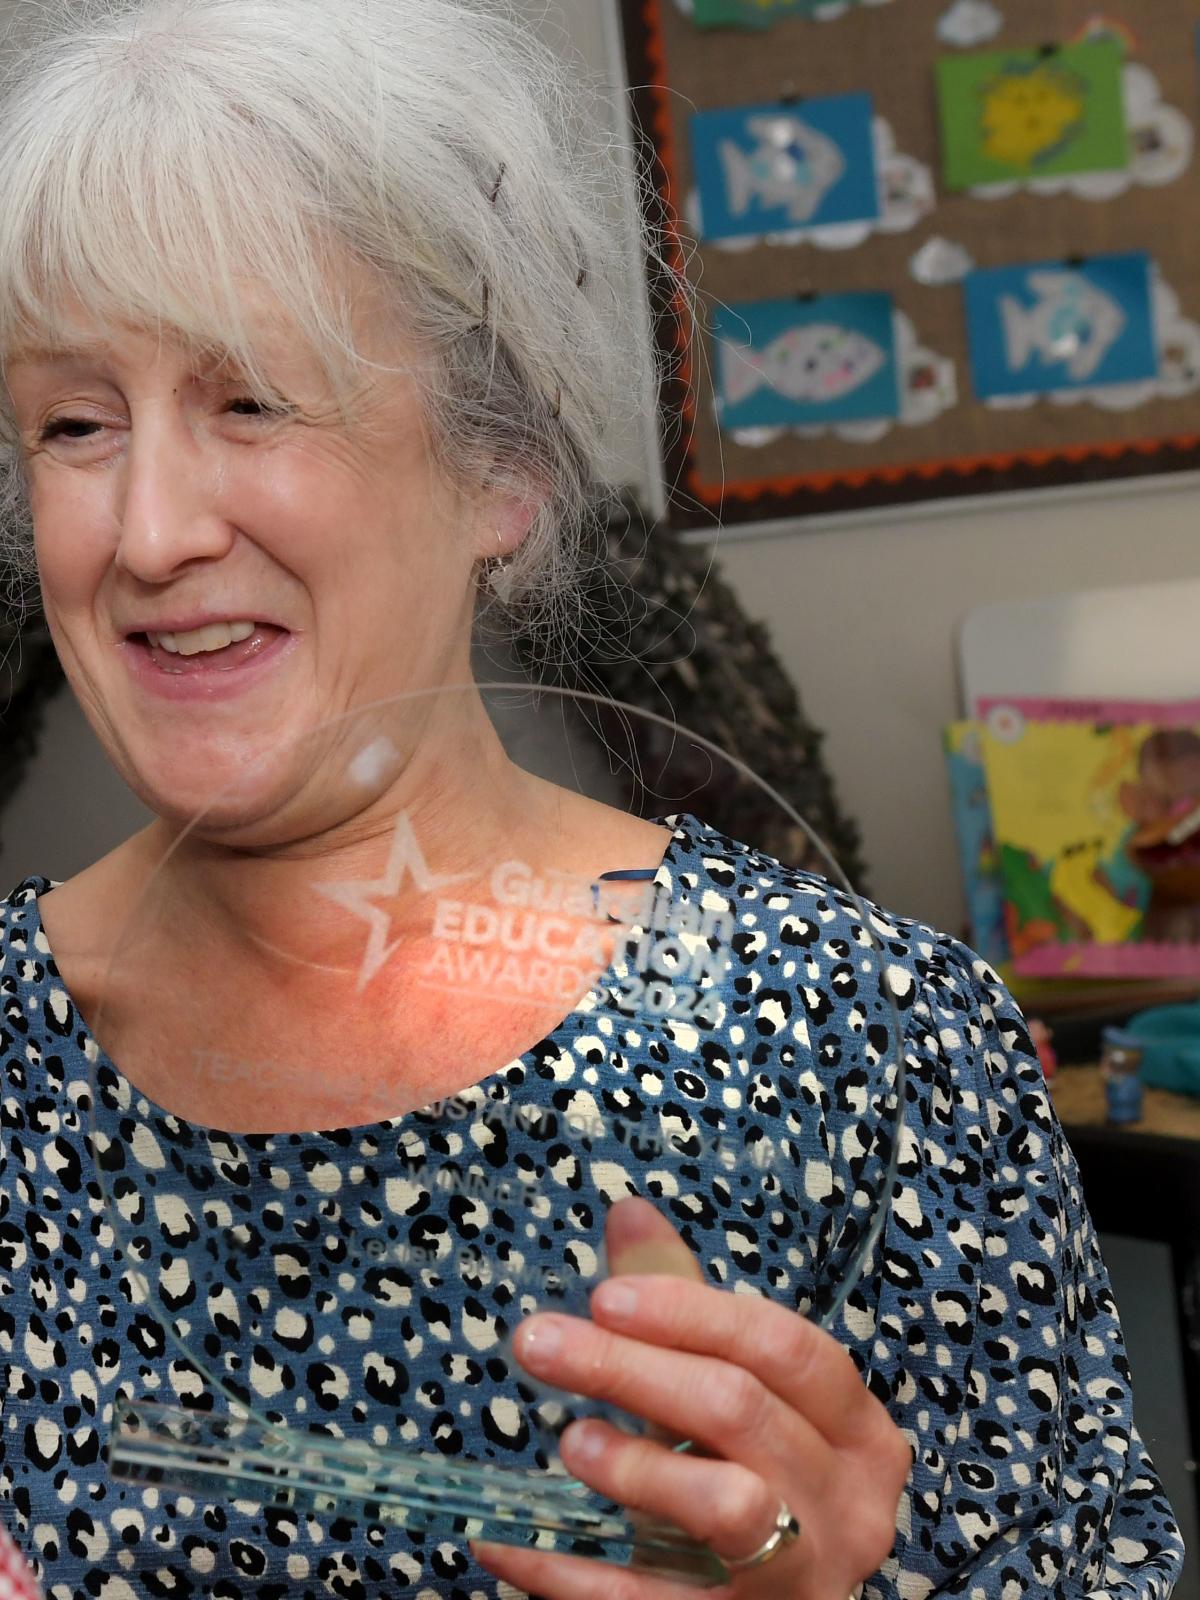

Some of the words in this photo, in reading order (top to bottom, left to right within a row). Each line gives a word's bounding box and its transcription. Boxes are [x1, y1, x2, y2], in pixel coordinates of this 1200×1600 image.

[490, 859, 736, 942] Guardian
[421, 942, 611, 1002] AWARDS
[618, 976, 721, 1018] 2024
[432, 899, 728, 983] EDUCATION
[408, 1162, 542, 1206] WINNER
